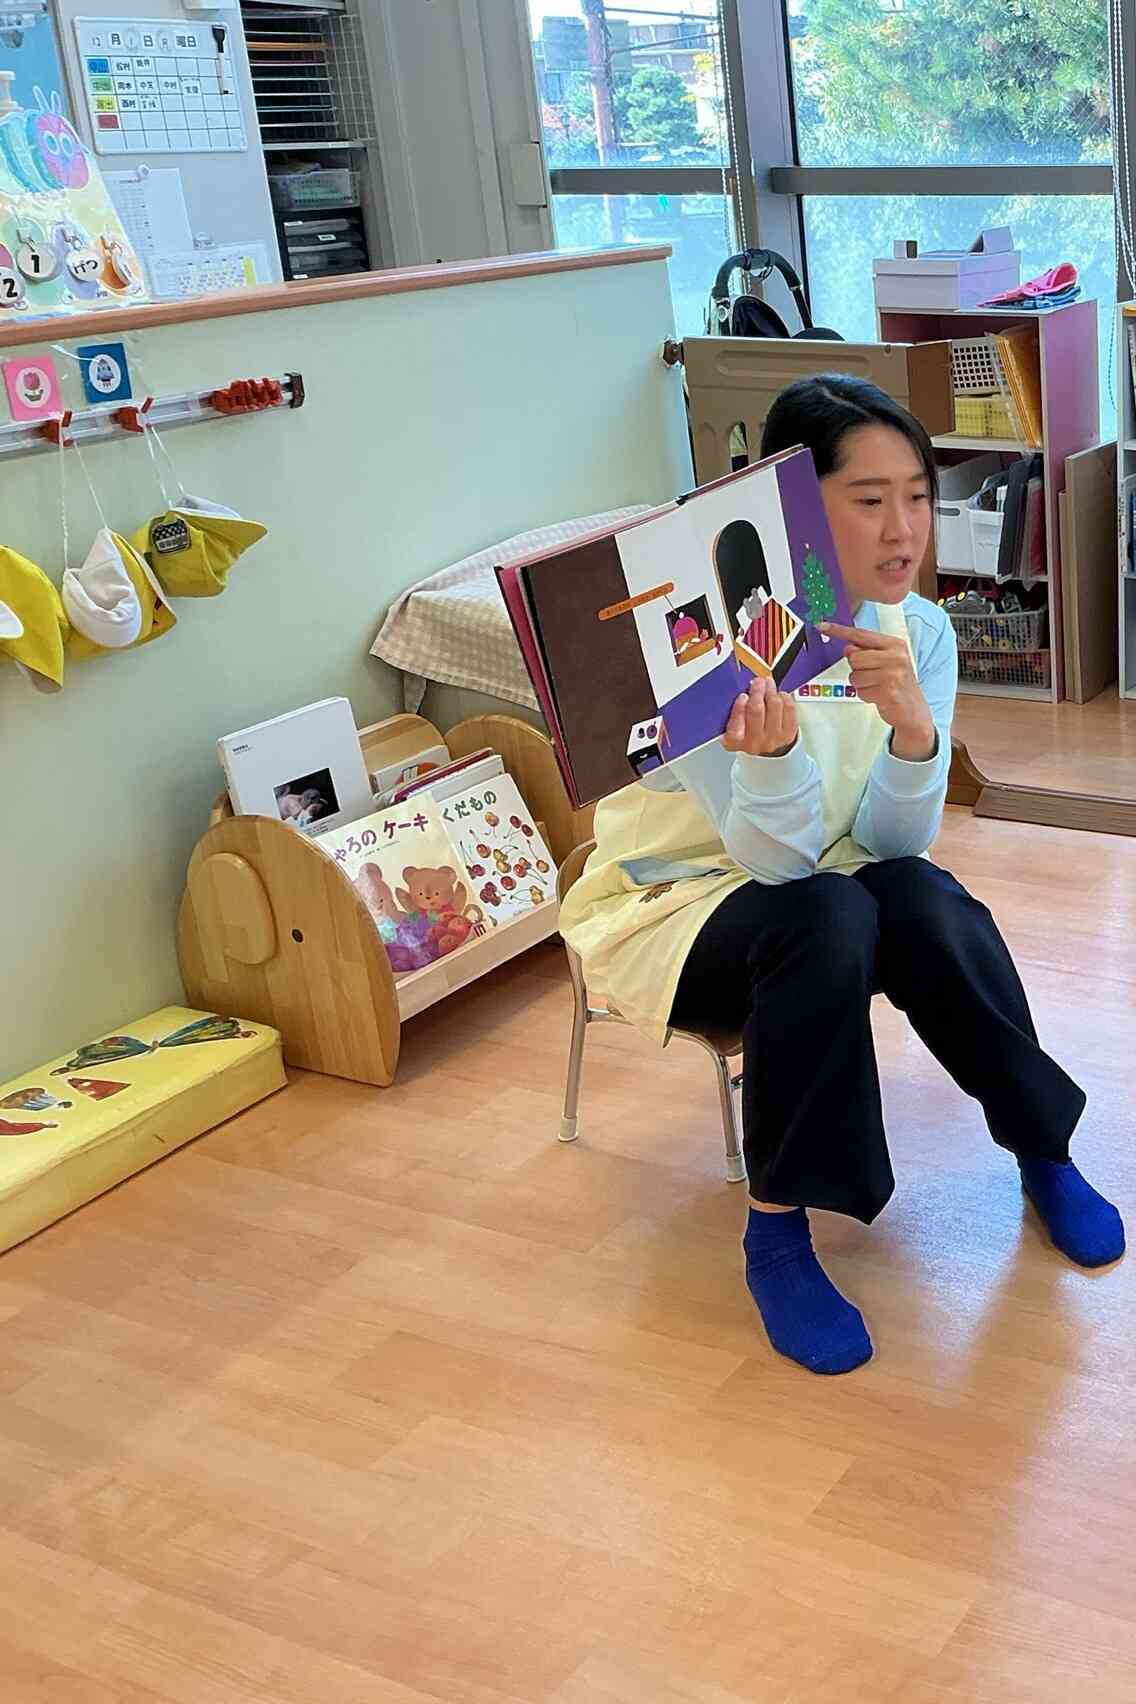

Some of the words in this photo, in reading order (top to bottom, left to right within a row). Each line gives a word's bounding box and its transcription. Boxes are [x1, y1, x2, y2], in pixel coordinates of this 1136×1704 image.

[111, 33, 121, 46] 月
[143, 35, 153, 47] 日
[176, 35, 197, 48] 曜日
[31, 254, 40, 273] 1
[74, 259, 98, 274] げつ
[441, 790, 497, 823] くだもの
[383, 813, 429, 839] ケーキ
